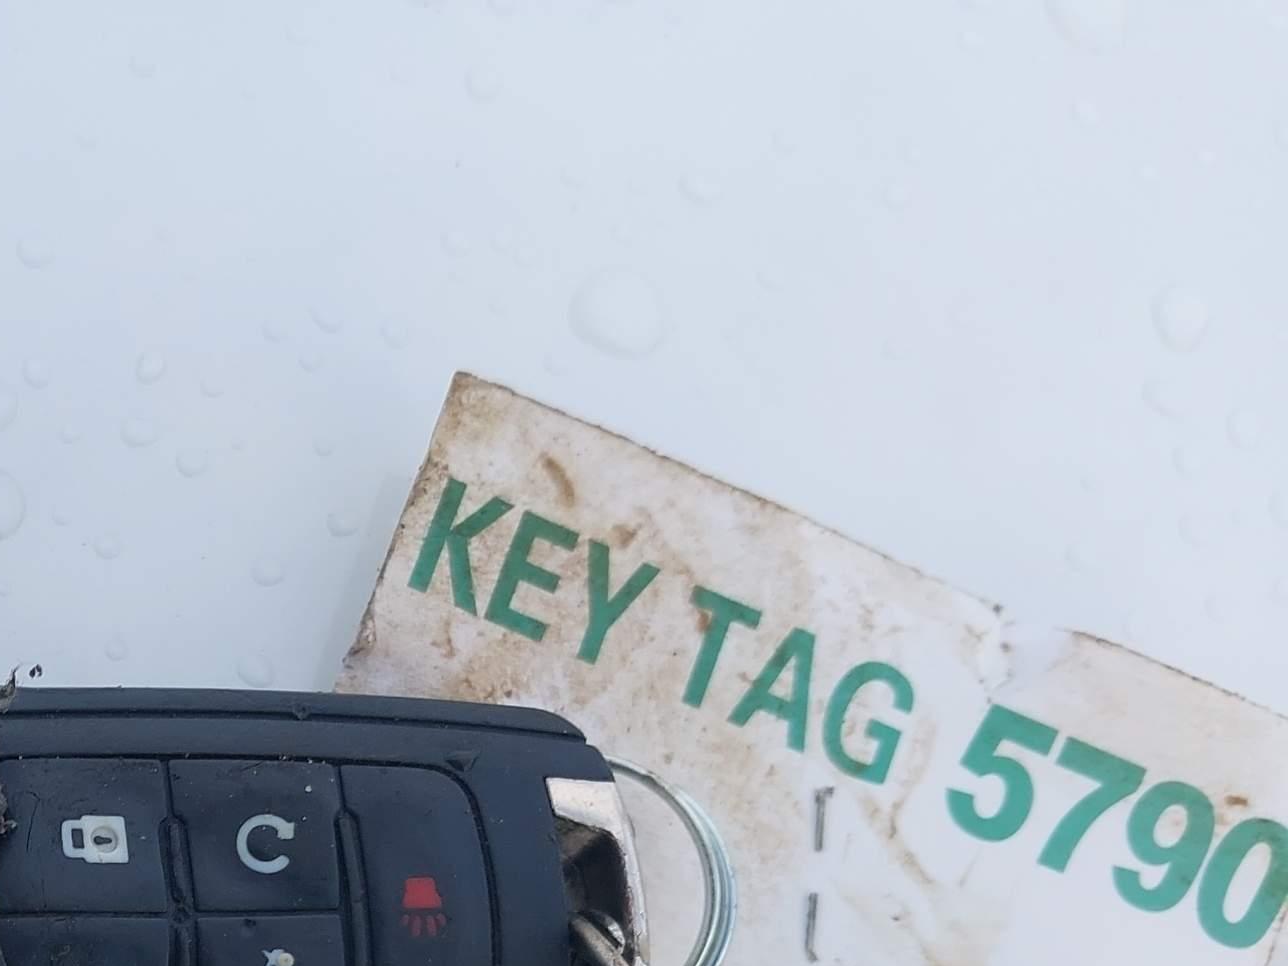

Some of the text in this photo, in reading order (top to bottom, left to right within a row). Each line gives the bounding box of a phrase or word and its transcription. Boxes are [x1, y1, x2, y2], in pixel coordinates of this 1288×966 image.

[408, 480, 1288, 949] KEY TAG 5790
